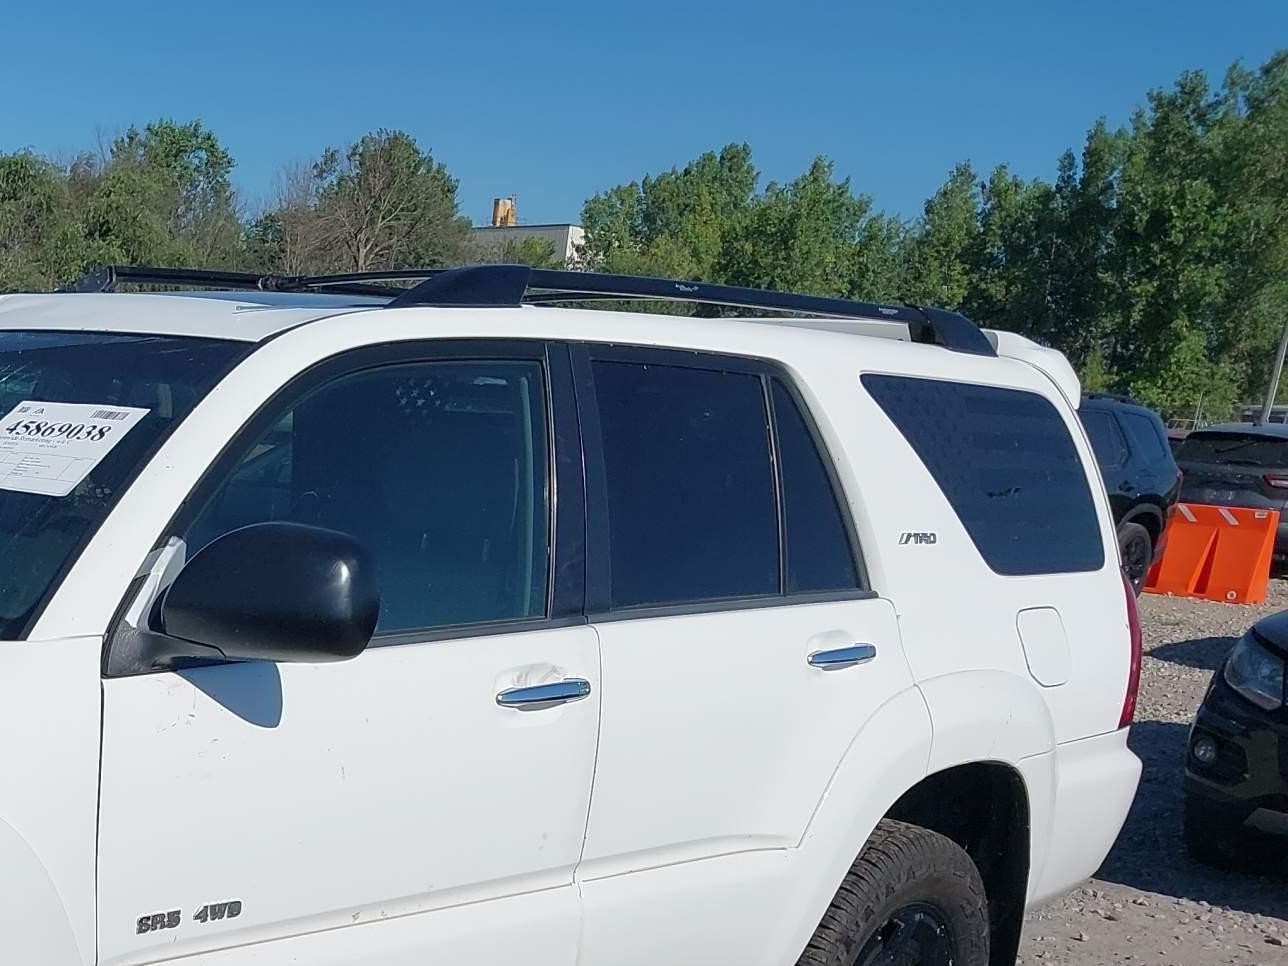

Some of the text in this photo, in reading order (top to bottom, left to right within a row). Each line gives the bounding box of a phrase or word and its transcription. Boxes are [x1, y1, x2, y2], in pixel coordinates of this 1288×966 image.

[6, 419, 112, 442] 45869038
[136, 900, 242, 935] SR5 4WD
